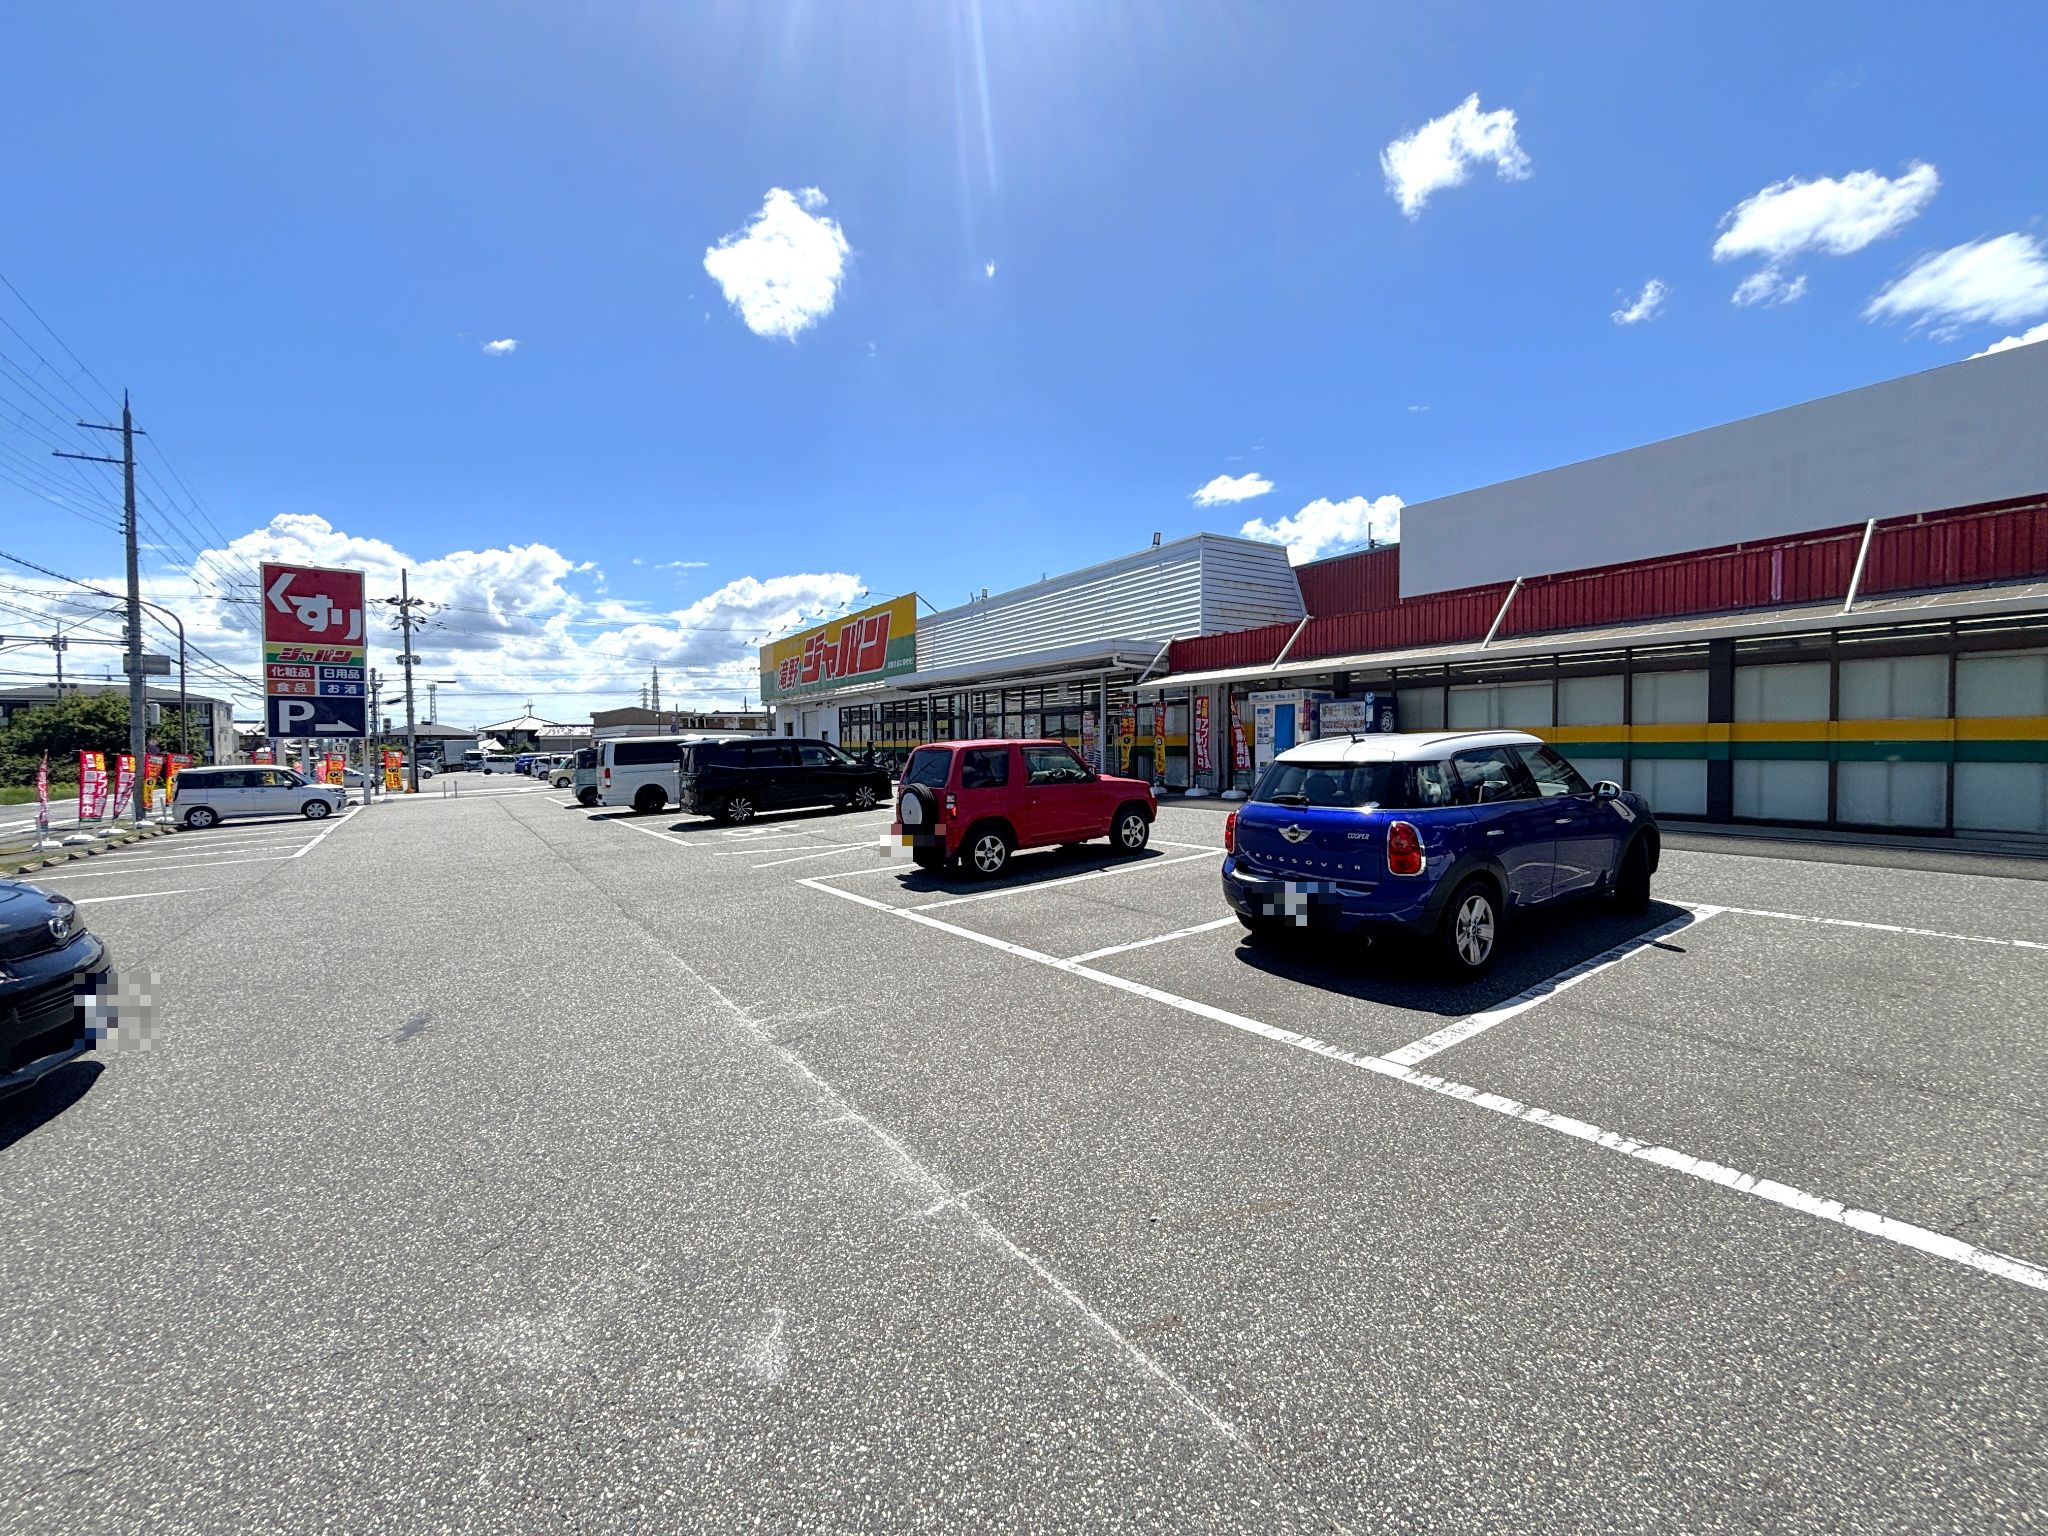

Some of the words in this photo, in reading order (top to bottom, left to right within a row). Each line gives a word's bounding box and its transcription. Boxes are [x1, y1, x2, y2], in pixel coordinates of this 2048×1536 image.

[267, 573, 360, 640] くすり
[800, 610, 891, 686] ジャパン
[277, 647, 352, 664] ジャパン
[271, 666, 311, 678] 化粧品
[323, 669, 360, 680] 日用品
[276, 682, 307, 693] 食品
[327, 684, 357, 695] お酒
[278, 700, 315, 733] P
[1347, 832, 1370, 841] COOPER
[1244, 850, 1361, 870] CROSSOVER
